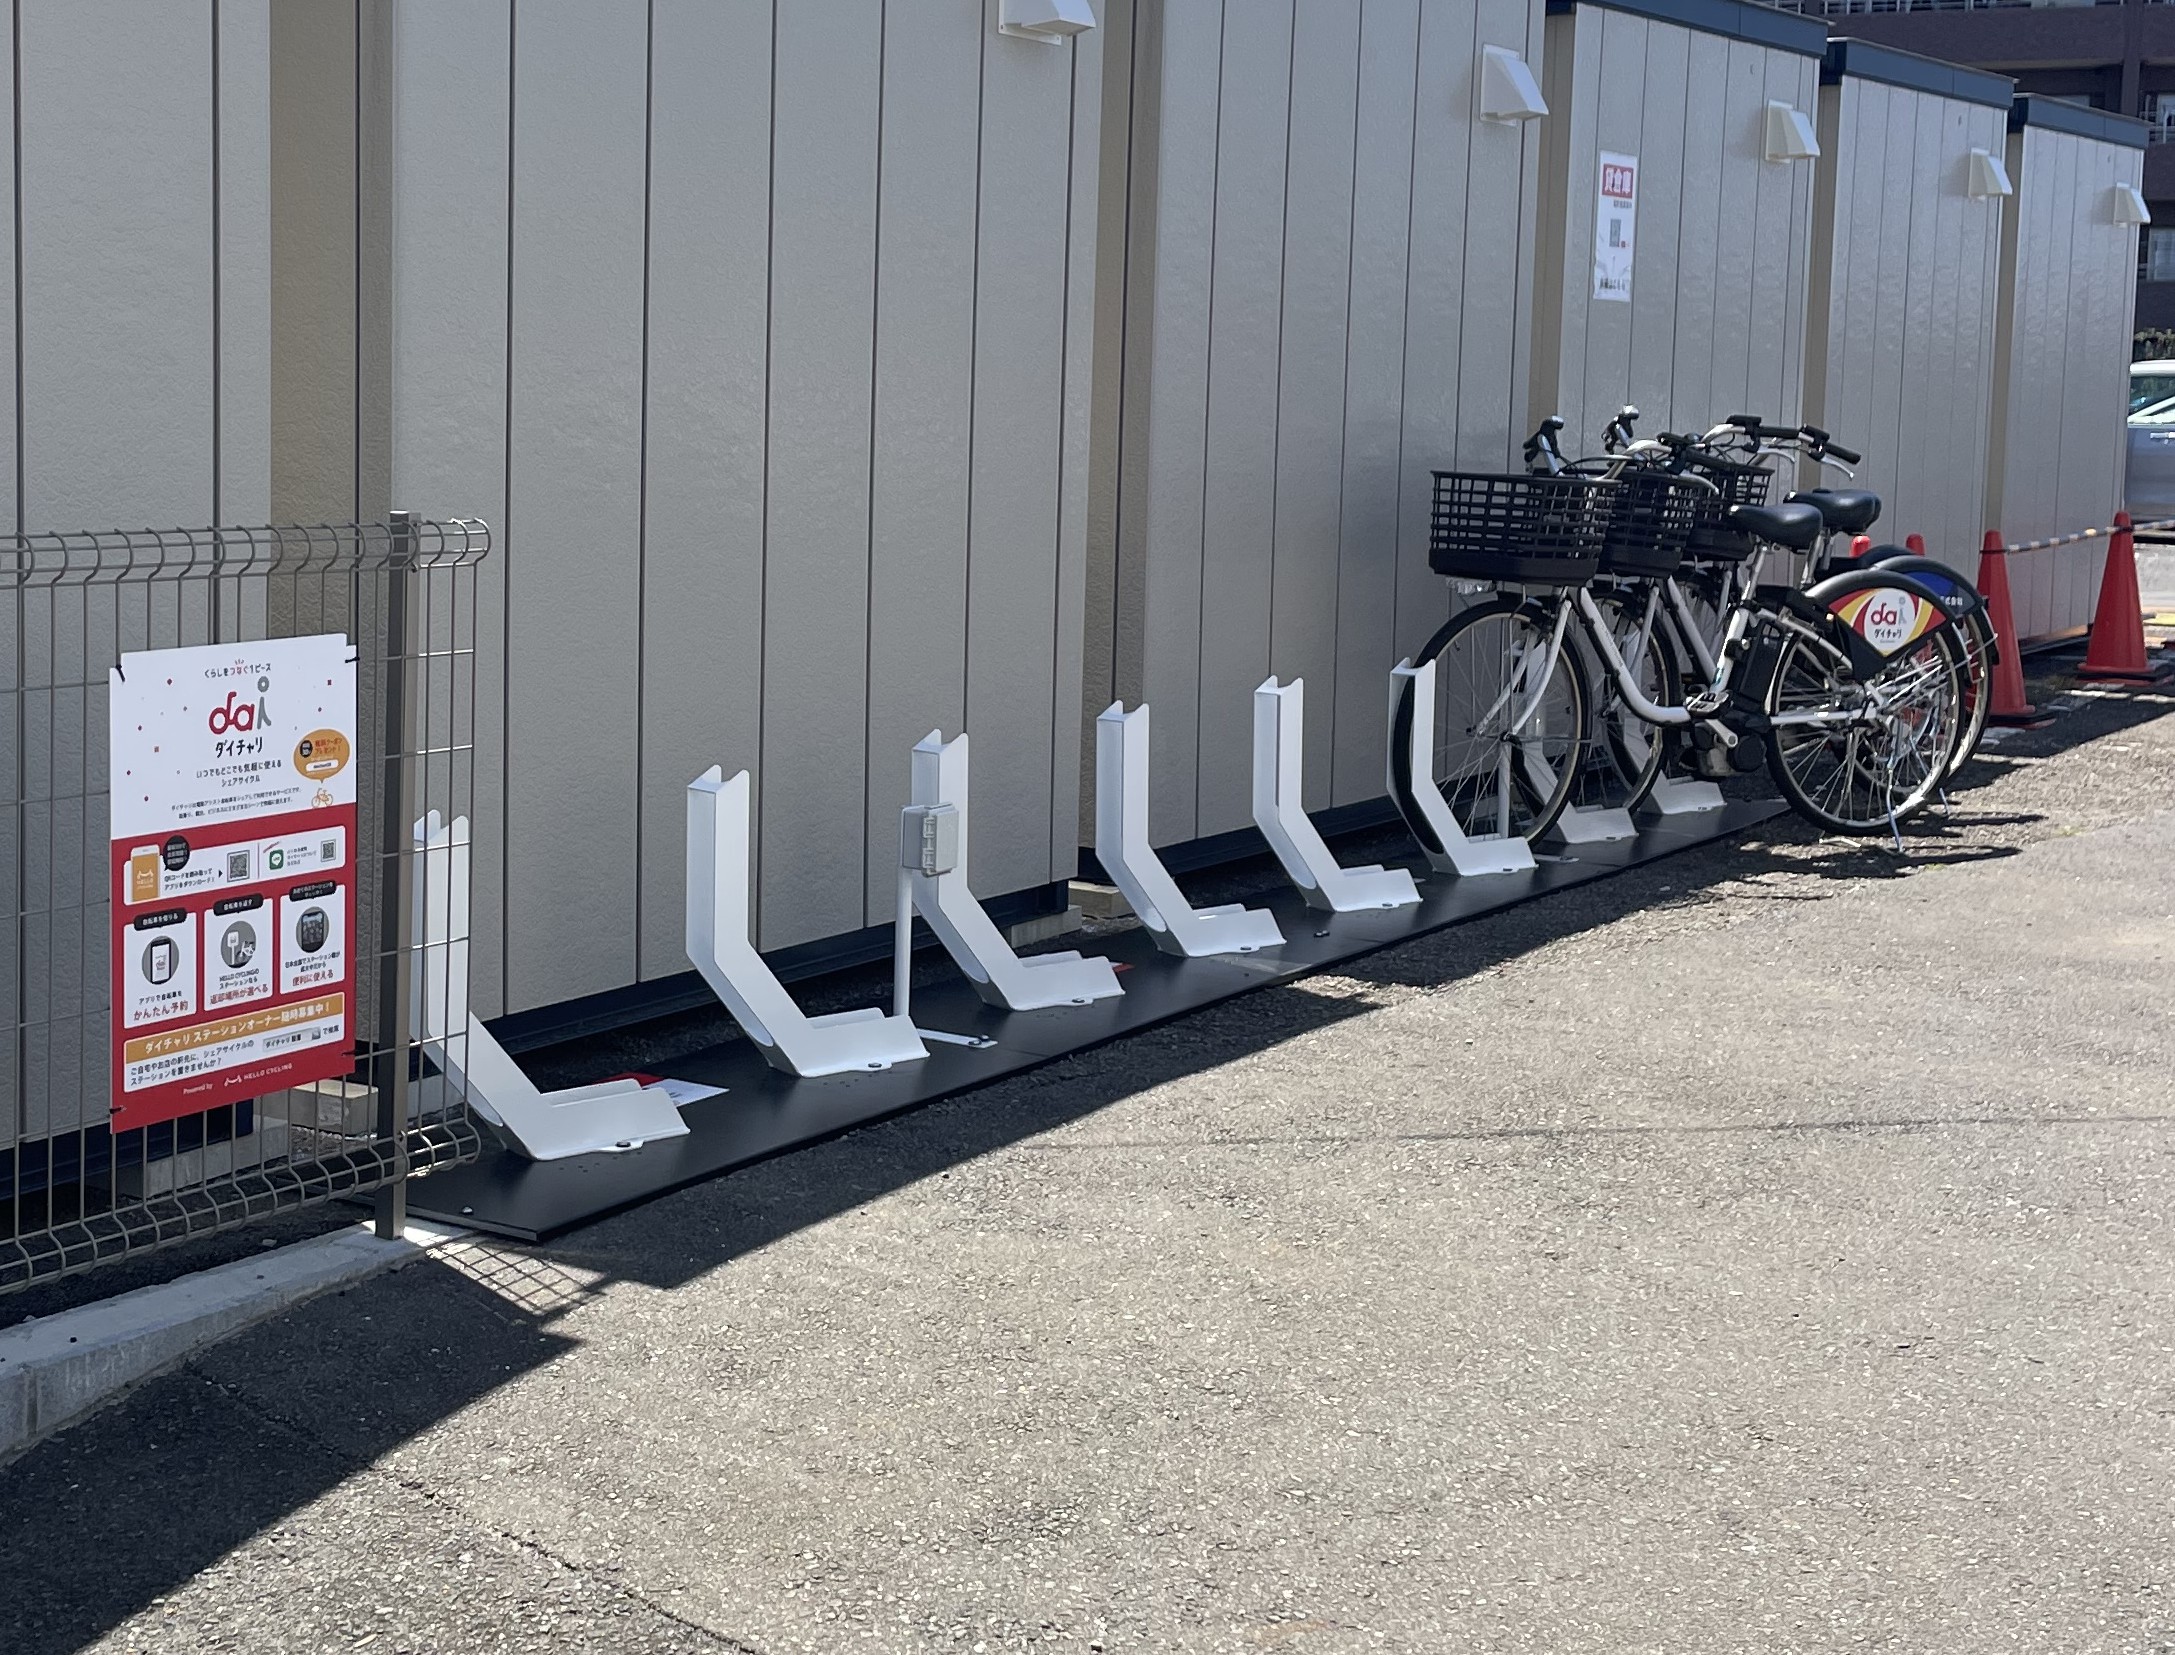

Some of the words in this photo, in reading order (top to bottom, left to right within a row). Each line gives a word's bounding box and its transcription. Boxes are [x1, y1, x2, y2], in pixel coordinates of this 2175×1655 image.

[1874, 629, 1902, 639] ダイチャリ
[208, 676, 272, 735] dai
[215, 736, 263, 758] ダイチャリ
[196, 759, 282, 778] いつでもどこでも気軽に使える
[221, 775, 260, 787] シェアサイクル
[133, 1000, 189, 1021] かんたん予約
[243, 1069, 265, 1080] HELLO
[266, 1062, 293, 1075] CYCLING
[183, 1084, 205, 1095] Powered
